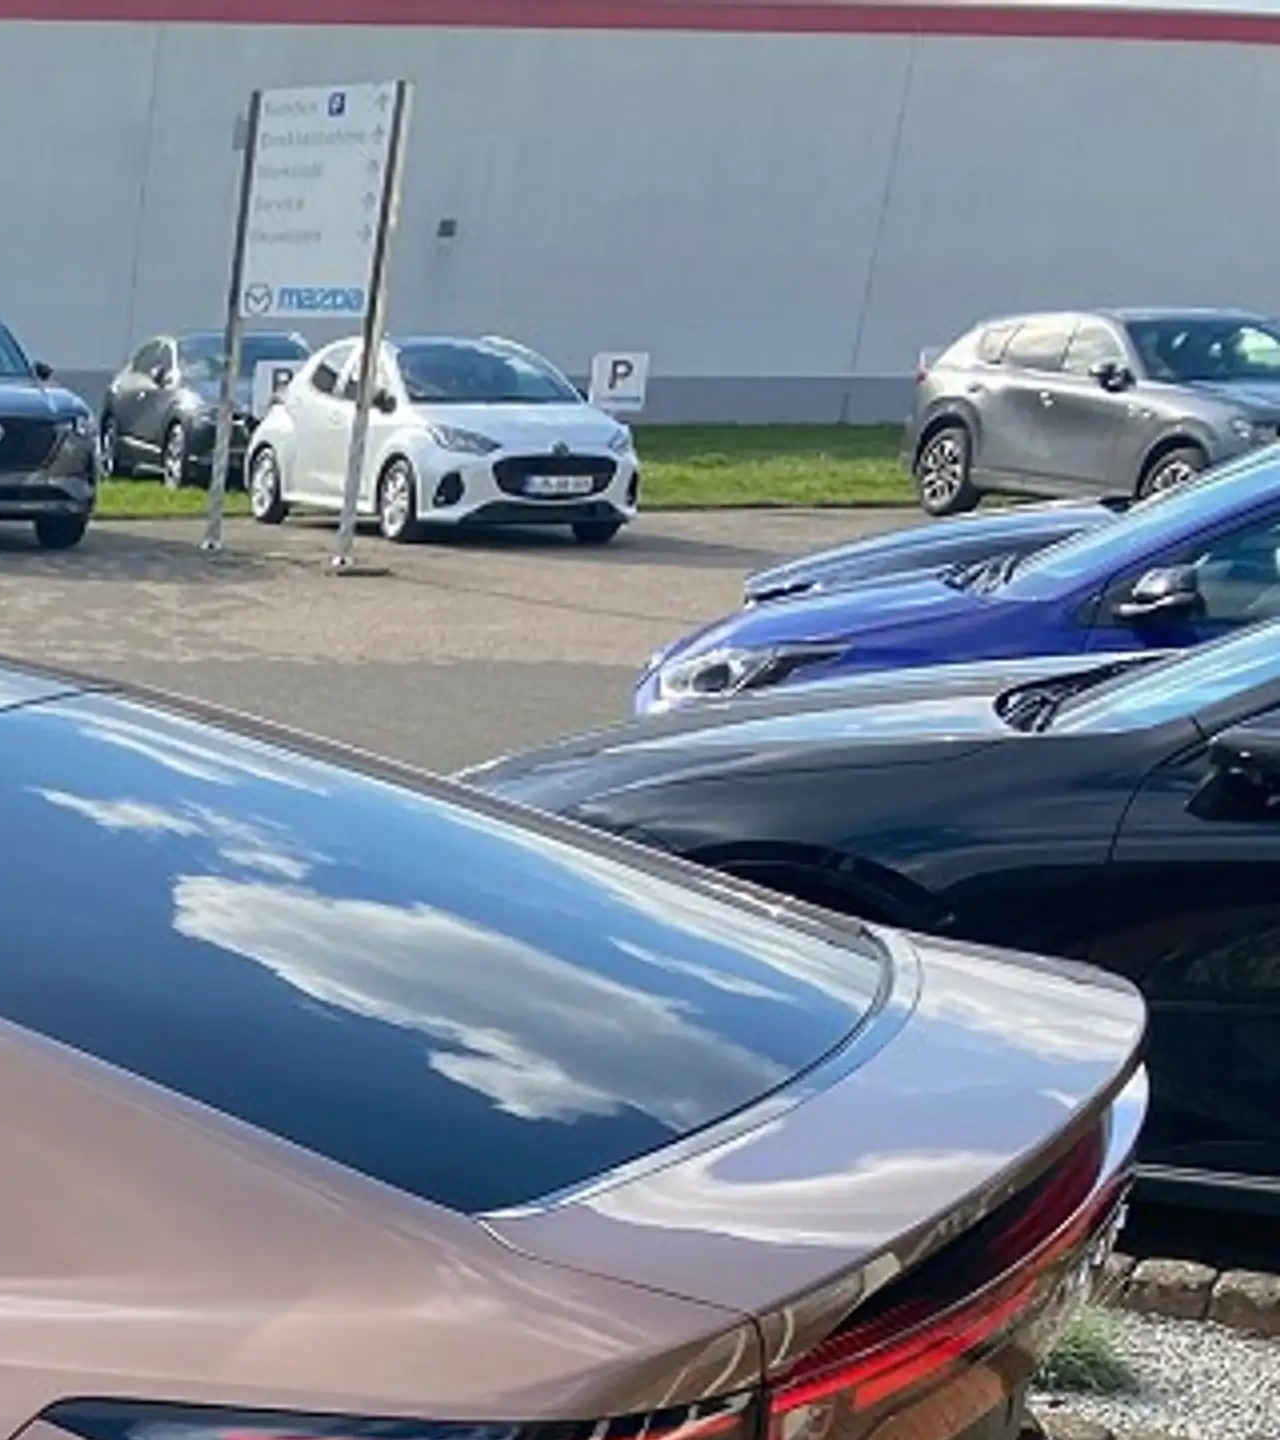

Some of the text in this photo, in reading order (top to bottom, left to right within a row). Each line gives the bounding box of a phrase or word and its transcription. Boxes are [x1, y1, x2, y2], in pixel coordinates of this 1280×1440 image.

[277, 287, 365, 313] mazda
[272, 367, 294, 394] P
[608, 360, 634, 390] P
